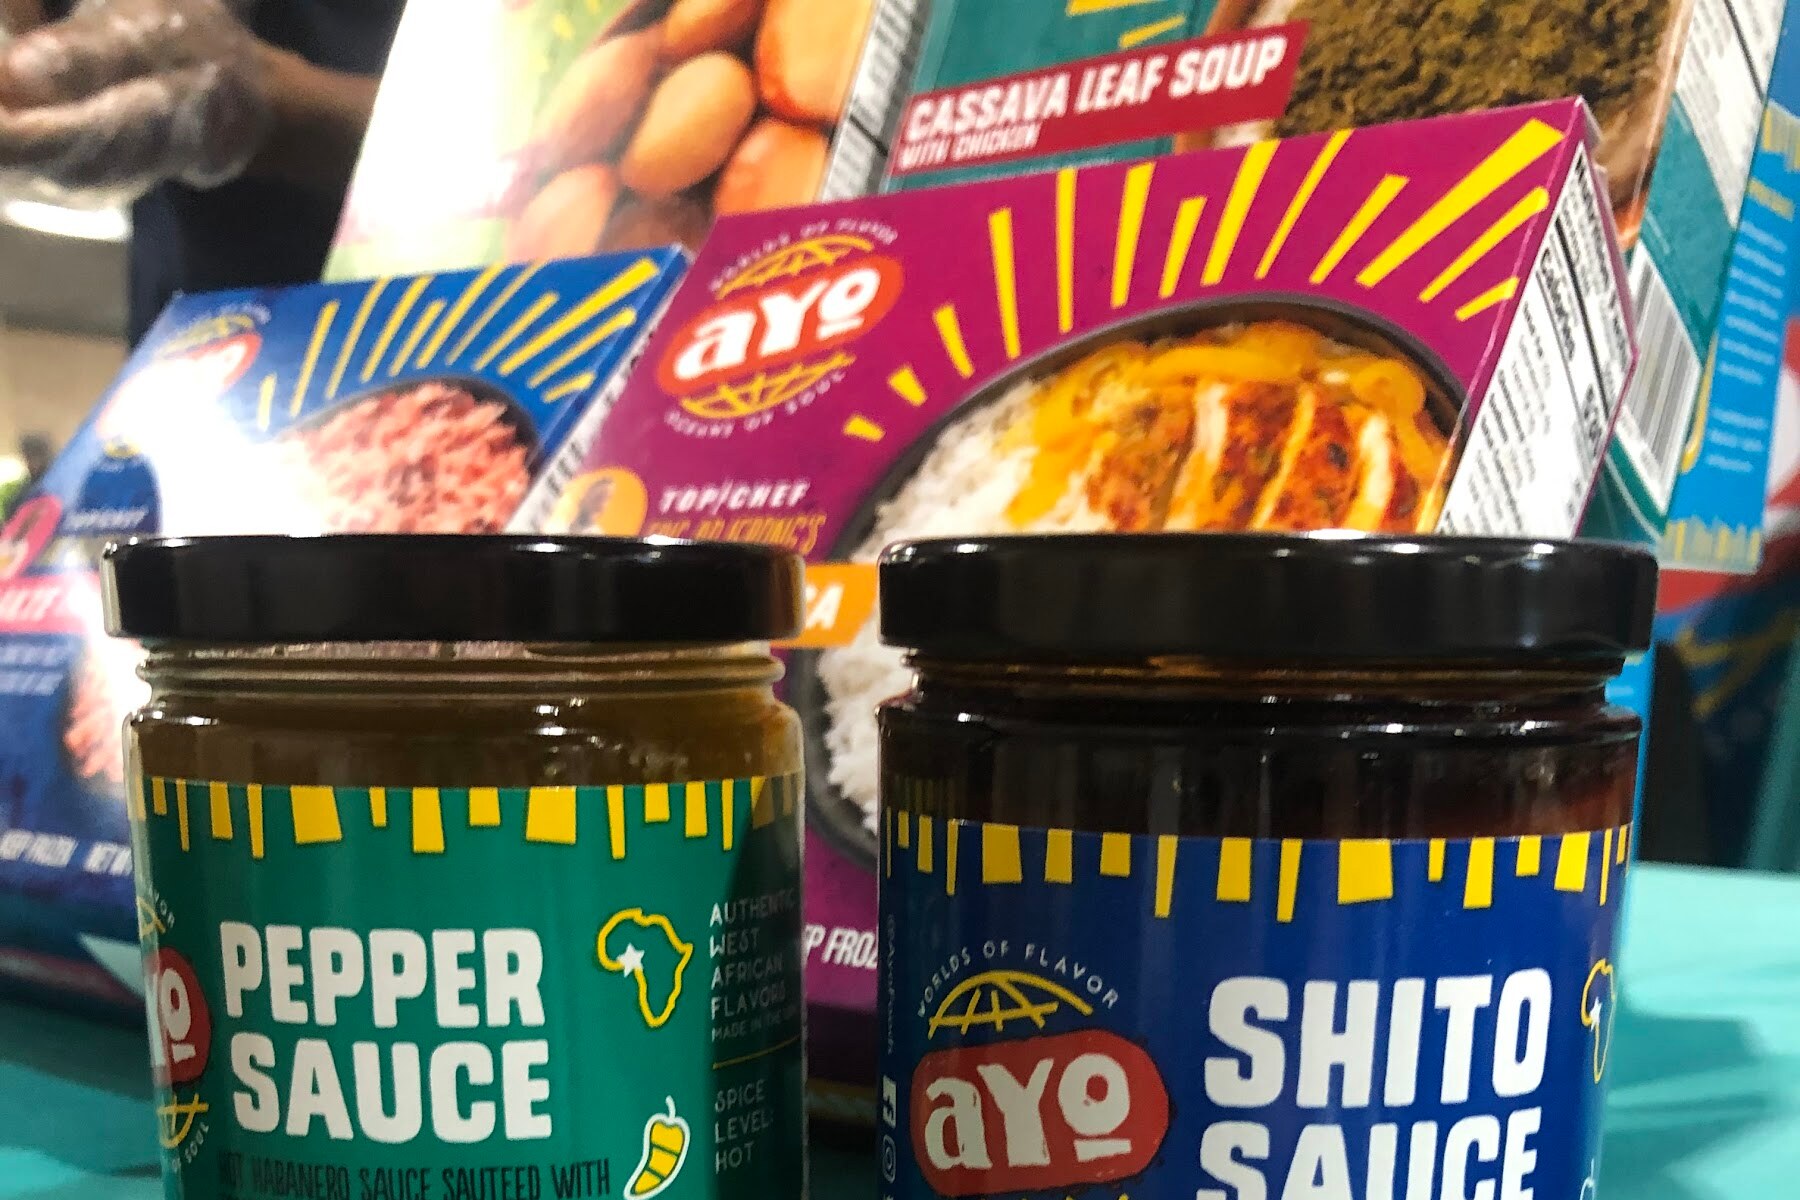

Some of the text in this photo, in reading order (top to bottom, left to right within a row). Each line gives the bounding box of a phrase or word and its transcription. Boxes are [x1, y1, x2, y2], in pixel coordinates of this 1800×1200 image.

[904, 35, 1288, 142] CASSAVA LEAF SOUP
[899, 139, 949, 169] WITH
[709, 926, 761, 959] WEST
[220, 920, 545, 1029] PEPPER
[710, 954, 784, 991] AFRICAN
[918, 945, 971, 1018] WORLDS
[982, 939, 1009, 957] OF
[1024, 942, 1120, 1009] FLAVOR
[1204, 967, 1552, 1109] SHITO
[230, 1031, 552, 1144] SAUCE
[714, 1078, 767, 1114] SPICE
[715, 1140, 754, 1176] HOT
